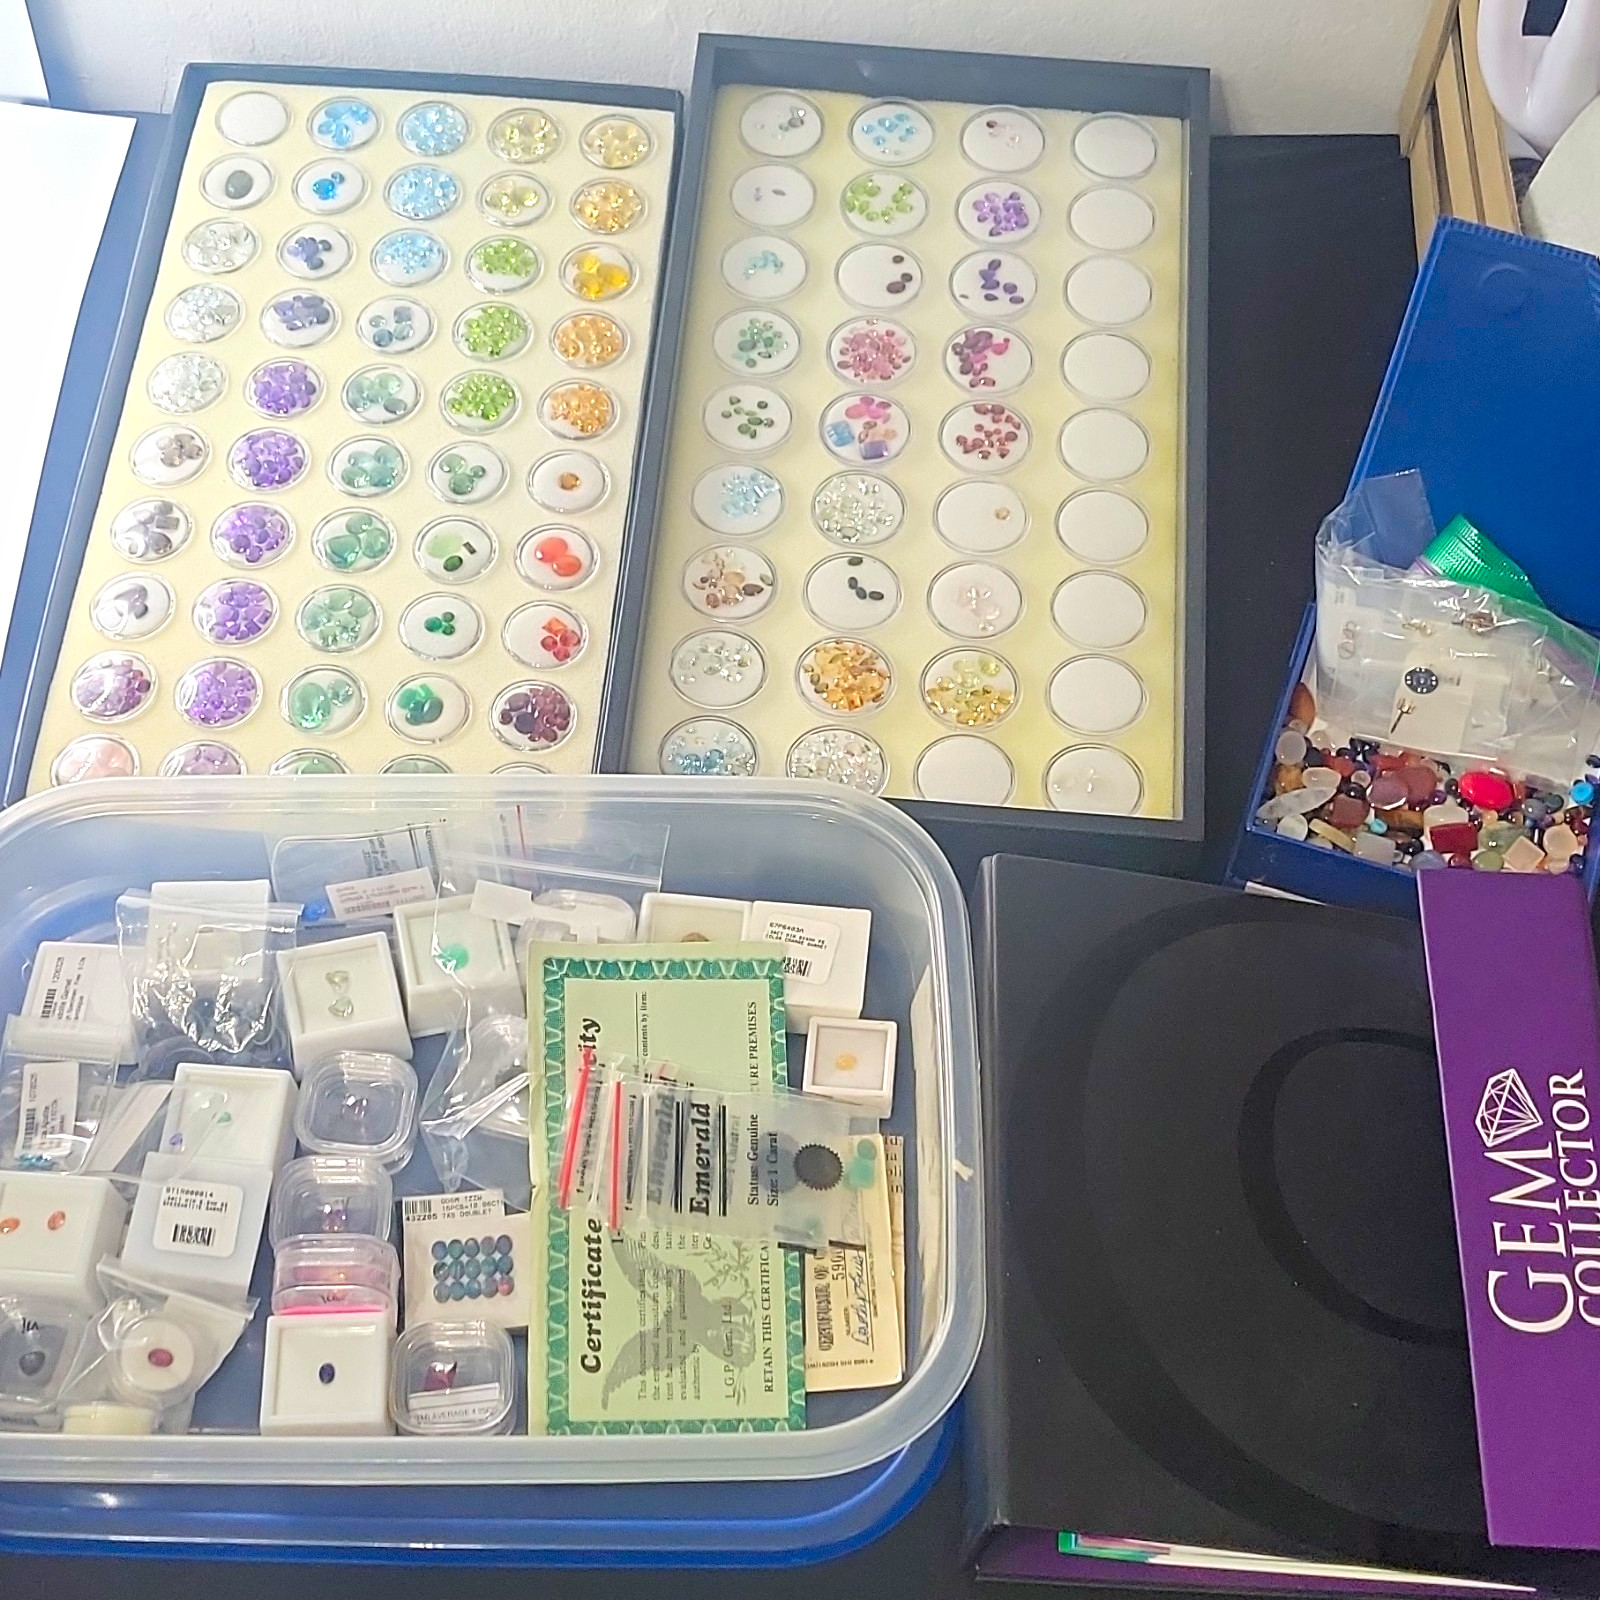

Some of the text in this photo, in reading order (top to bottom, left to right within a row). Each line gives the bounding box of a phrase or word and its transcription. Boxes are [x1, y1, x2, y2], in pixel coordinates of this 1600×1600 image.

[747, 1001, 758, 1060] PREMISES
[688, 1102, 711, 1217] Emerald
[746, 1113, 759, 1206] Status: Genuine
[766, 1132, 778, 1164] Carat
[766, 1178, 779, 1207] Size:
[1484, 1141, 1574, 1333] GEM
[579, 1218, 606, 1374] Certificate
[761, 1313, 773, 1343] THIS
[762, 1346, 774, 1393] RETAIN
